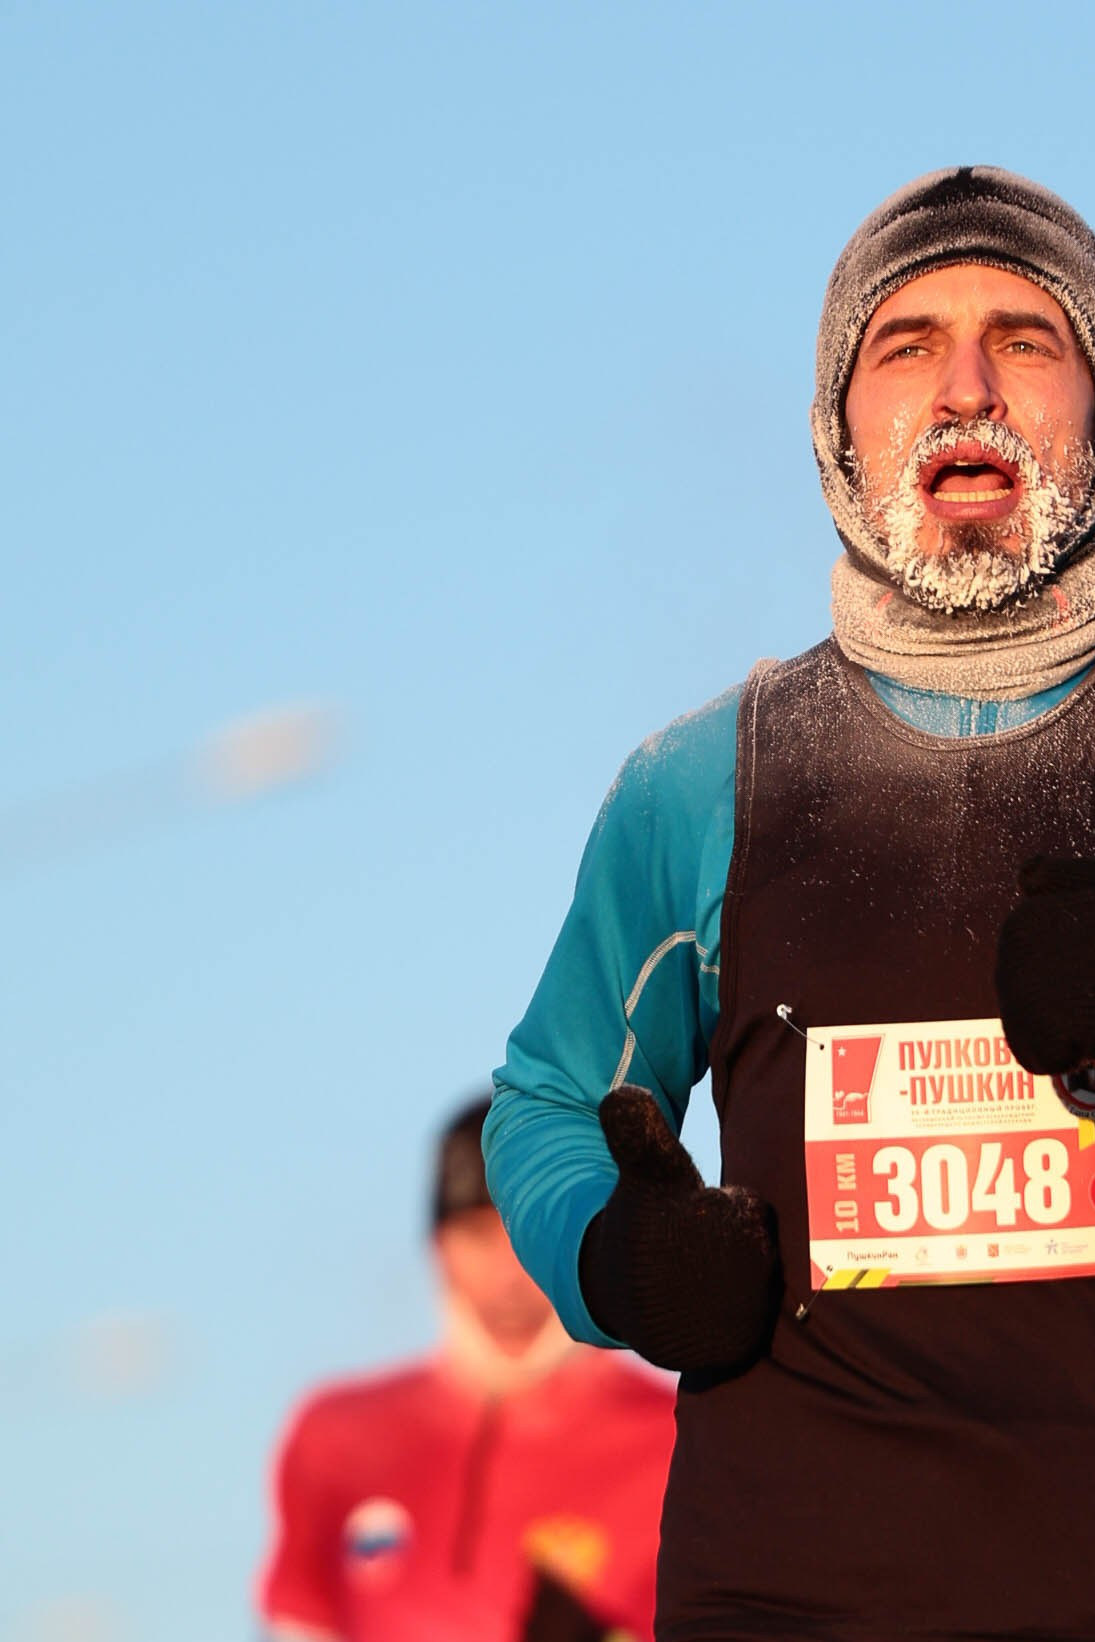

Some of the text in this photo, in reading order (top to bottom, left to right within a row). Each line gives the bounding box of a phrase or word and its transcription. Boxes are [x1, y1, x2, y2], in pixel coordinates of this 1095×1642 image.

[898, 1036, 1012, 1071] ПУЛКОВ
[899, 1071, 1035, 1106] -ПУШКИН
[835, 1152, 860, 1233] 10 КМ
[872, 1138, 1072, 1233] 3048
